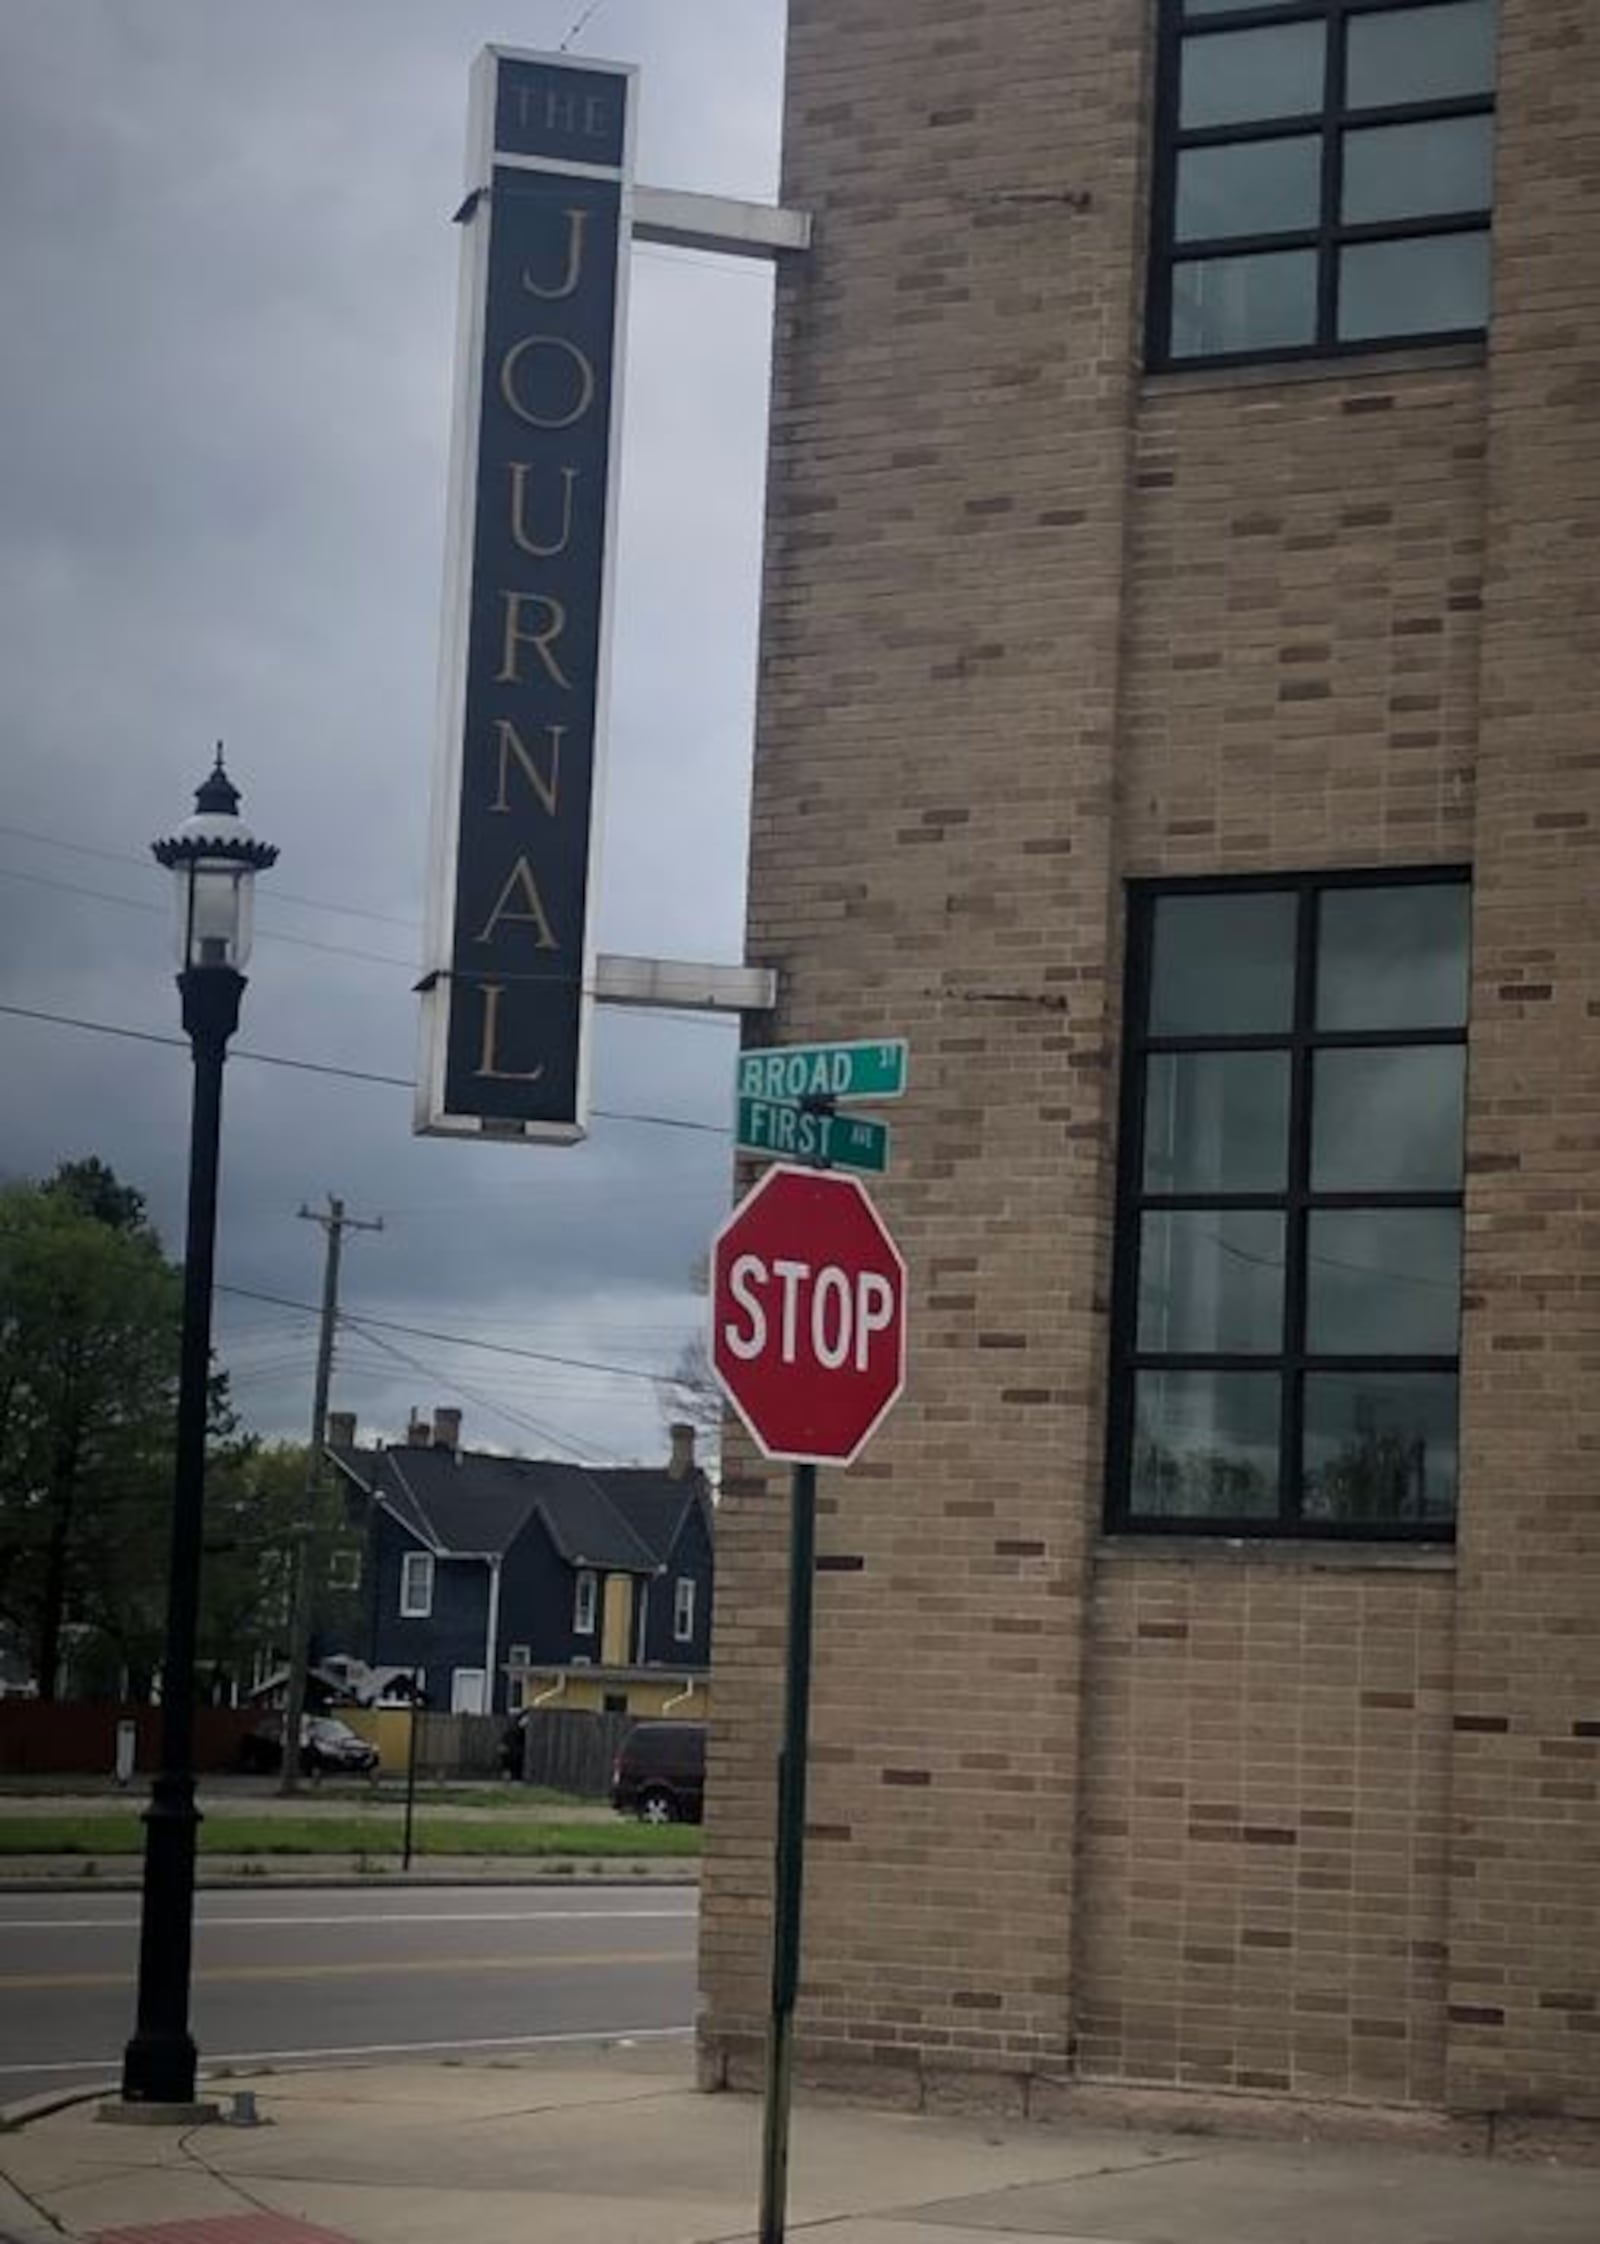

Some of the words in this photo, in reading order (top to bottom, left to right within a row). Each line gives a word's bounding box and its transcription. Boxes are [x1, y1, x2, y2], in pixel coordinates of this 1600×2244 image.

[509, 83, 610, 137] THE
[474, 208, 594, 1081] JOURNAL
[743, 1051, 853, 1097] BROAD
[750, 1101, 834, 1157] FIRST
[724, 1253, 895, 1373] STOP
